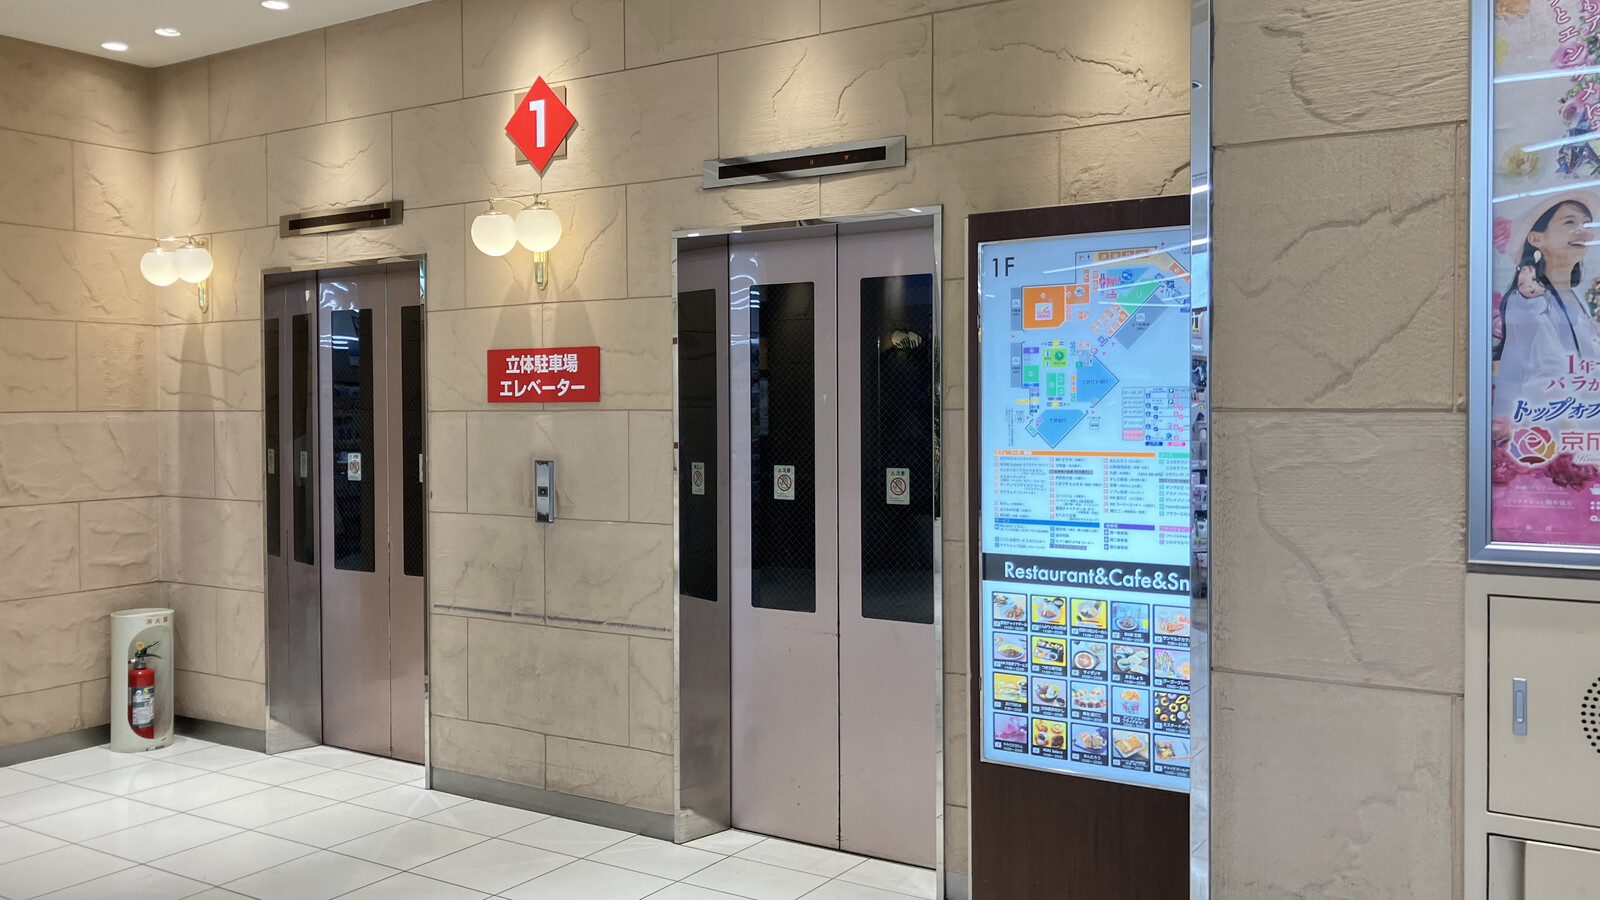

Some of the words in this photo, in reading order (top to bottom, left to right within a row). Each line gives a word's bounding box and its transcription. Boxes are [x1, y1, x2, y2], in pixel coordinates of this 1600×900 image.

[529, 99, 545, 148] 1
[992, 257, 1015, 277] 1F
[505, 353, 578, 375] 立体駐車場
[500, 379, 585, 397] エレベーター
